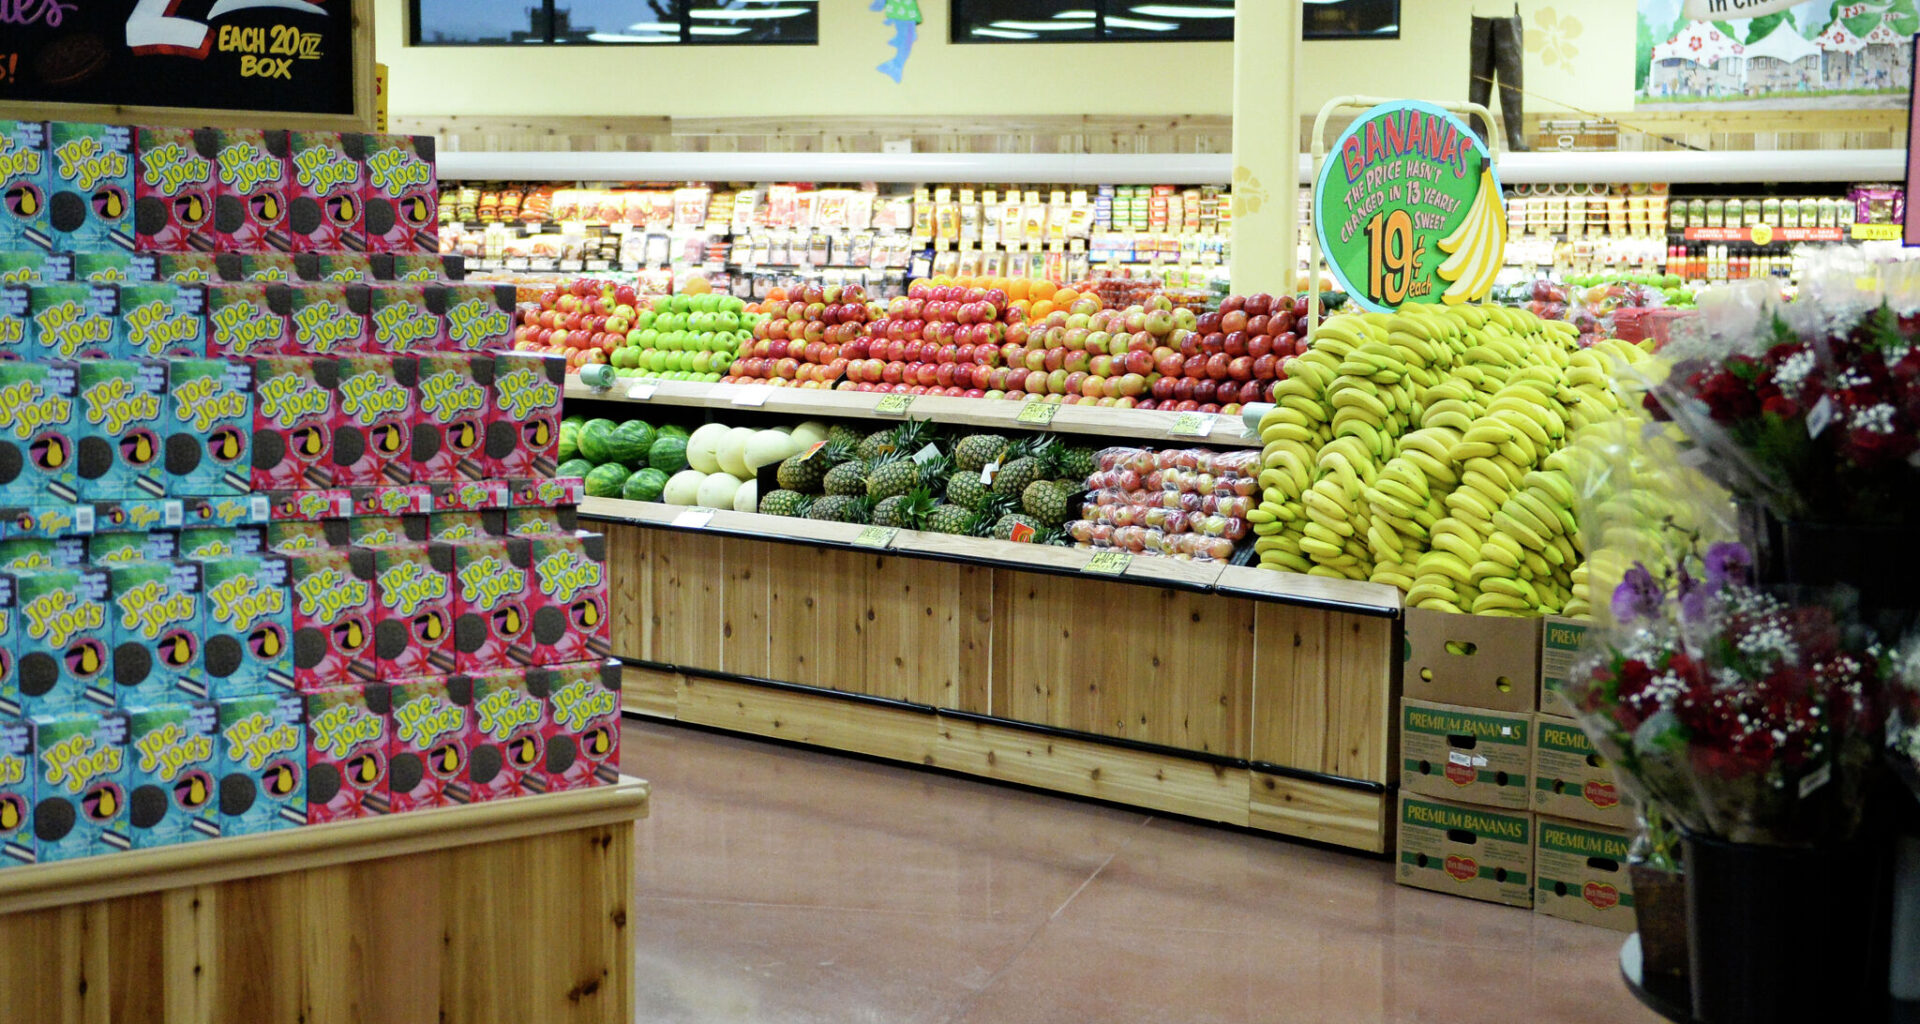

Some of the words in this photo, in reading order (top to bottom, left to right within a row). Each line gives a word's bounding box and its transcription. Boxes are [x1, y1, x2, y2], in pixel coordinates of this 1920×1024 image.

[218, 24, 266, 54] EACH
[240, 55, 293, 80] BOX
[1342, 108, 1474, 184] BANANAS
[1344, 184, 1365, 210] THE
[1365, 160, 1402, 194] PRICE
[1406, 159, 1443, 184] HASN'T
[1340, 190, 1385, 243] CHANGED
[1406, 180, 1421, 206] 13
[1423, 186, 1461, 214] YEARS!
[1409, 277, 1433, 298] each
[1409, 712, 1461, 732] PREMIUM
[1407, 805, 1462, 827] PREMIUM
[1463, 814, 1522, 838] BANANAS
[1545, 829, 1602, 852] PREMIUM
